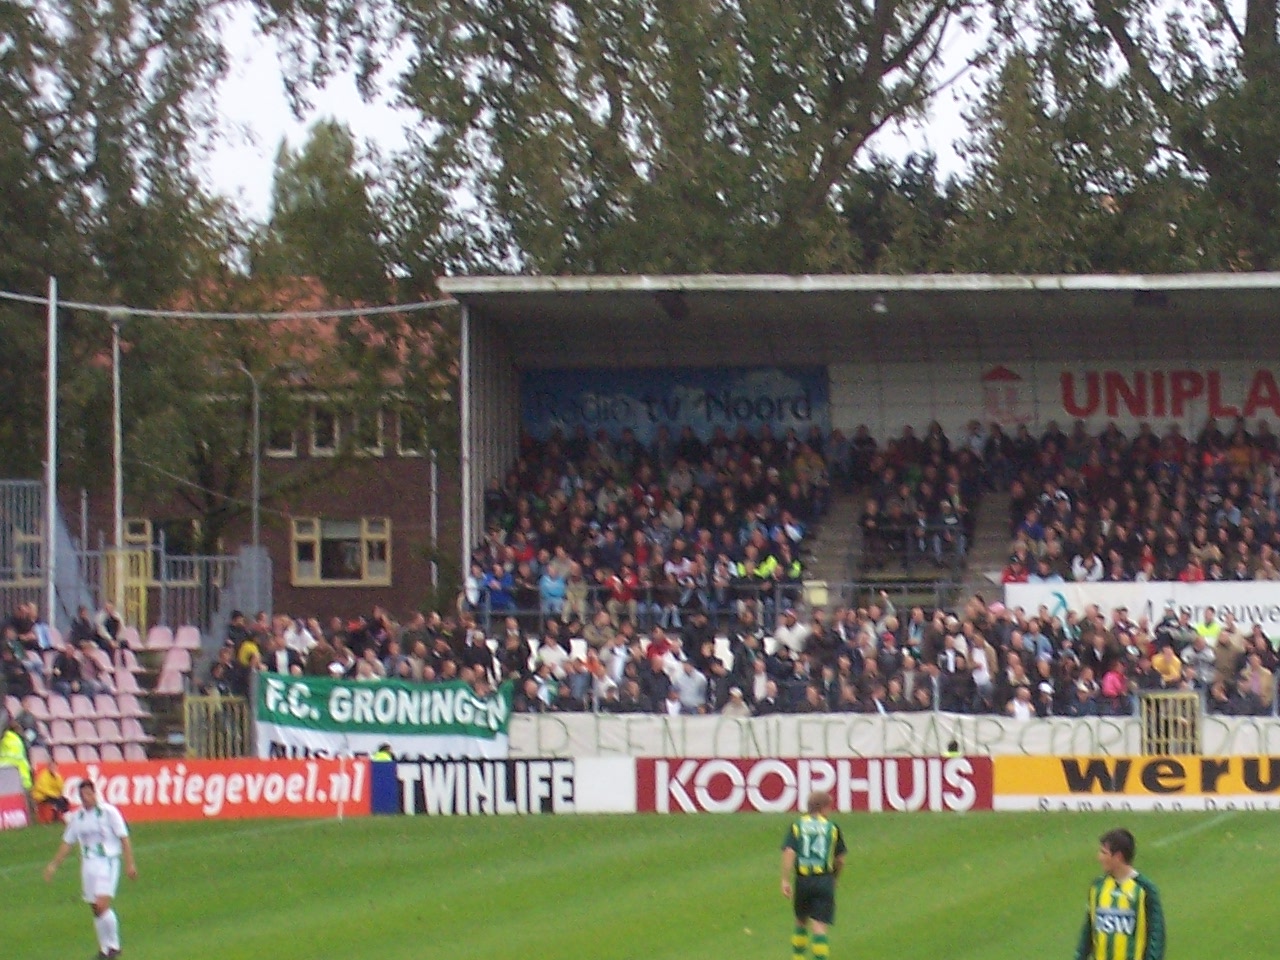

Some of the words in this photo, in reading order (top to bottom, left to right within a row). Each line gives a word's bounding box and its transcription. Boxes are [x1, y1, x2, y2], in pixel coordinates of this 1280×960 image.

[702, 389, 812, 421] Noord
[265, 677, 320, 721] F.C.
[328, 685, 508, 731] GRONINGEN
[62, 762, 366, 816] akantiegevoel.nl
[397, 760, 574, 816] TWINLIFE
[655, 759, 977, 813] KOOPHUIS
